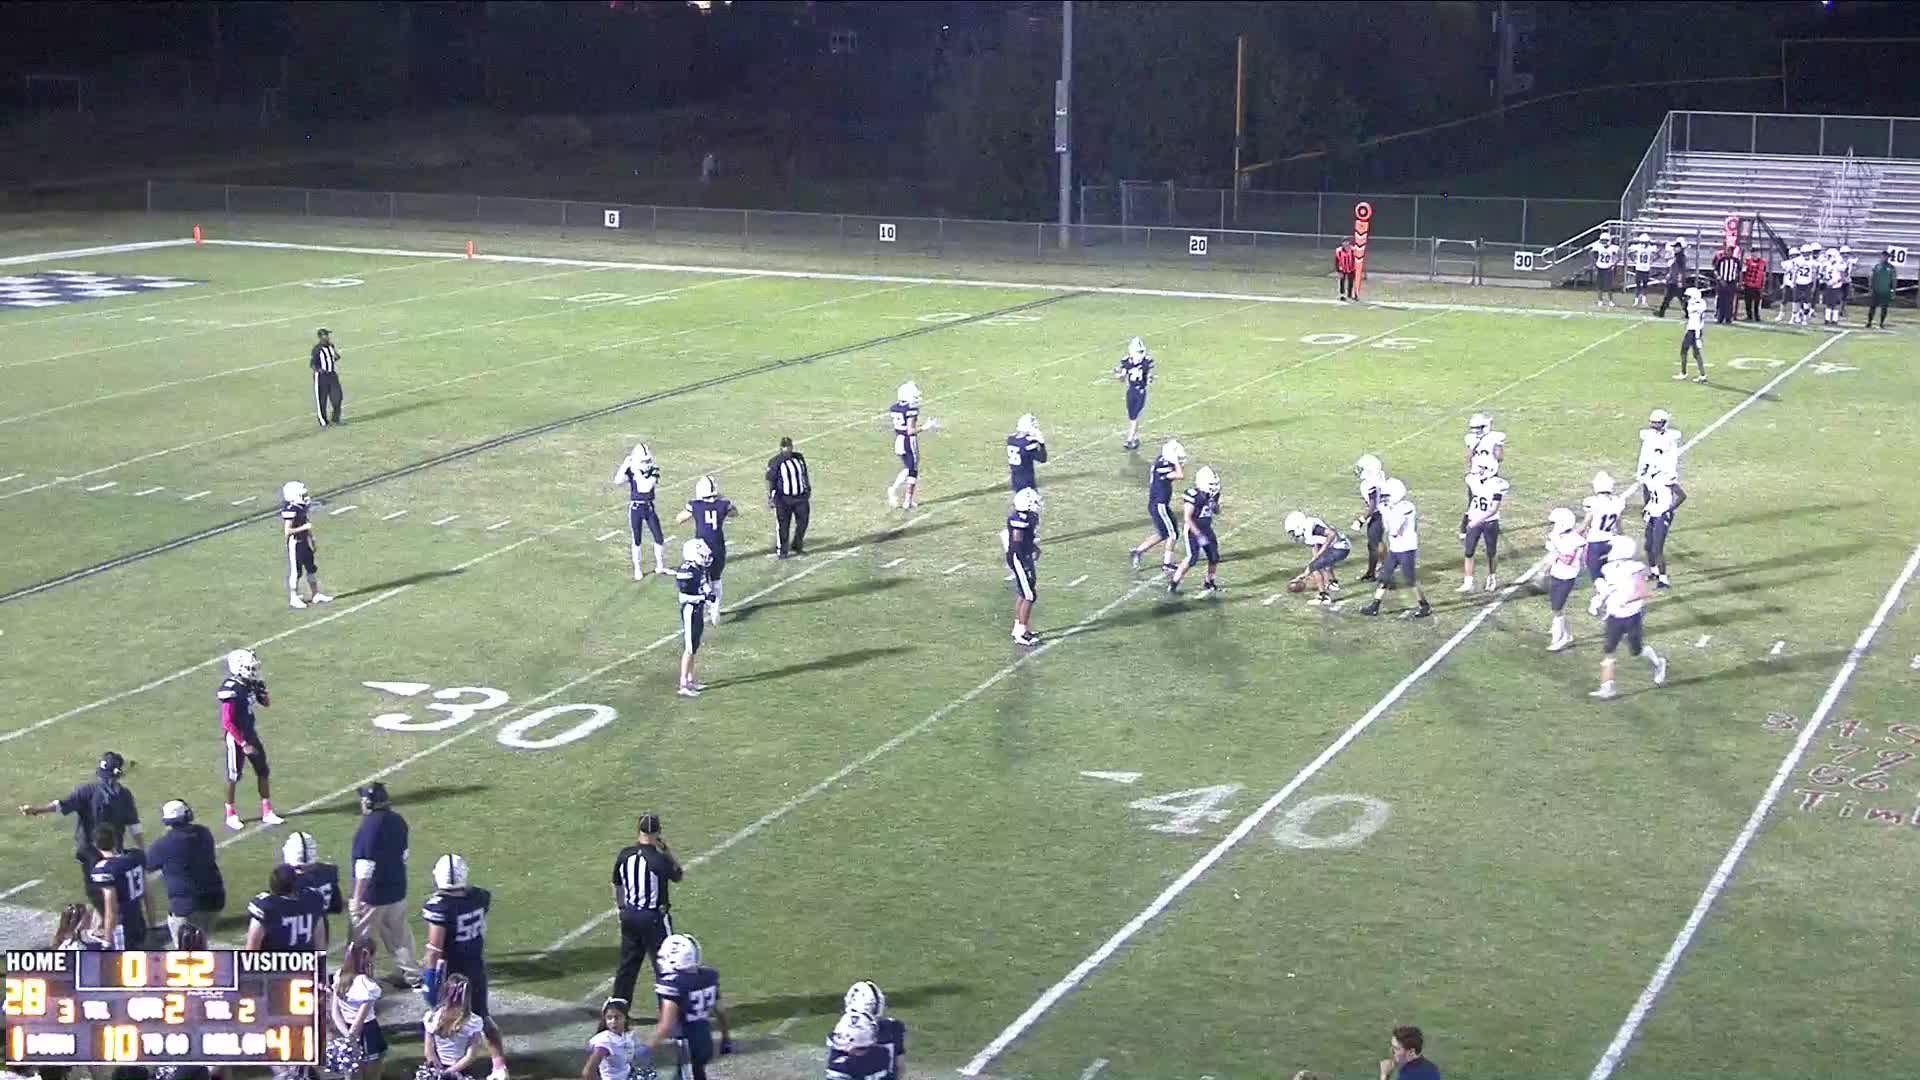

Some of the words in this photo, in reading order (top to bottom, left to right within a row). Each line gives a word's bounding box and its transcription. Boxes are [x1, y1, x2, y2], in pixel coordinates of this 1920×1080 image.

[881, 226, 894, 239] 10
[1191, 239, 1206, 251] 20
[1516, 255, 1531, 268] 30
[704, 510, 718, 531] 4
[1599, 513, 1618, 532] 12
[372, 686, 618, 749] 30
[1128, 782, 1392, 849] 40
[125, 865, 144, 900] 13
[281, 912, 313, 947] 74
